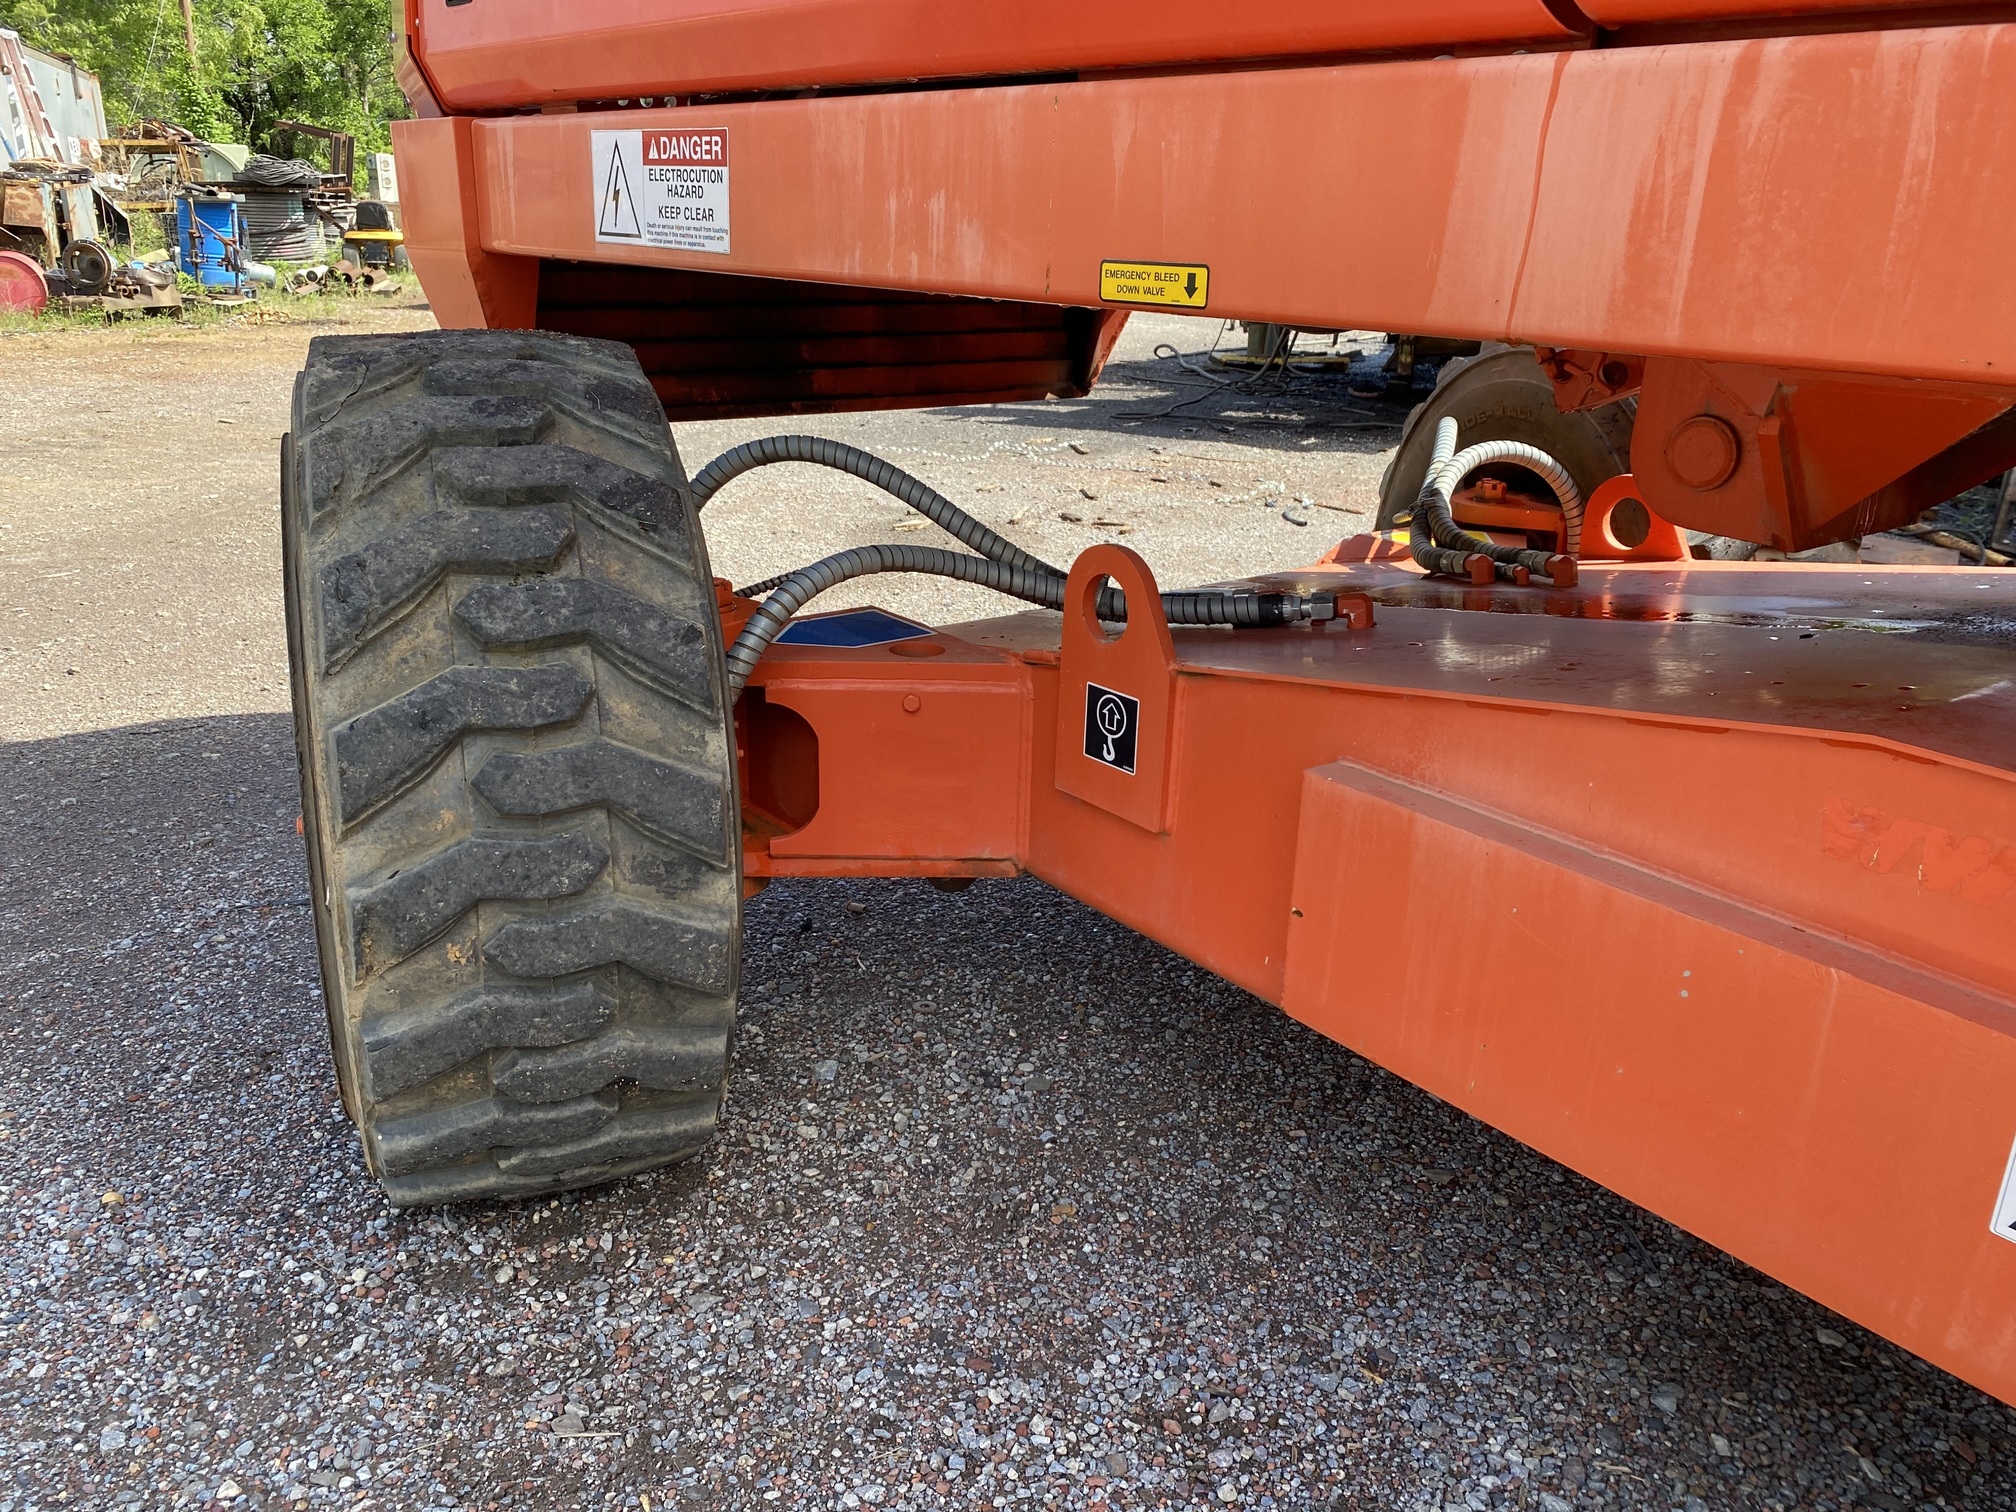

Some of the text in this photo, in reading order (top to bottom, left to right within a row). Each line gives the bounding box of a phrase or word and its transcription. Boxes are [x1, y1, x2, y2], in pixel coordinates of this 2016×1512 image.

[660, 135, 722, 160] DANGER
[648, 168, 723, 184] ELECTROCUTION
[667, 184, 704, 199] HAZARD
[658, 205, 715, 222] KEEP CLEAR
[712, 227, 728, 235] touching
[1105, 269, 1180, 282] EMERGENCY BLEED
[1116, 284, 1165, 296] DOWN VALVE
